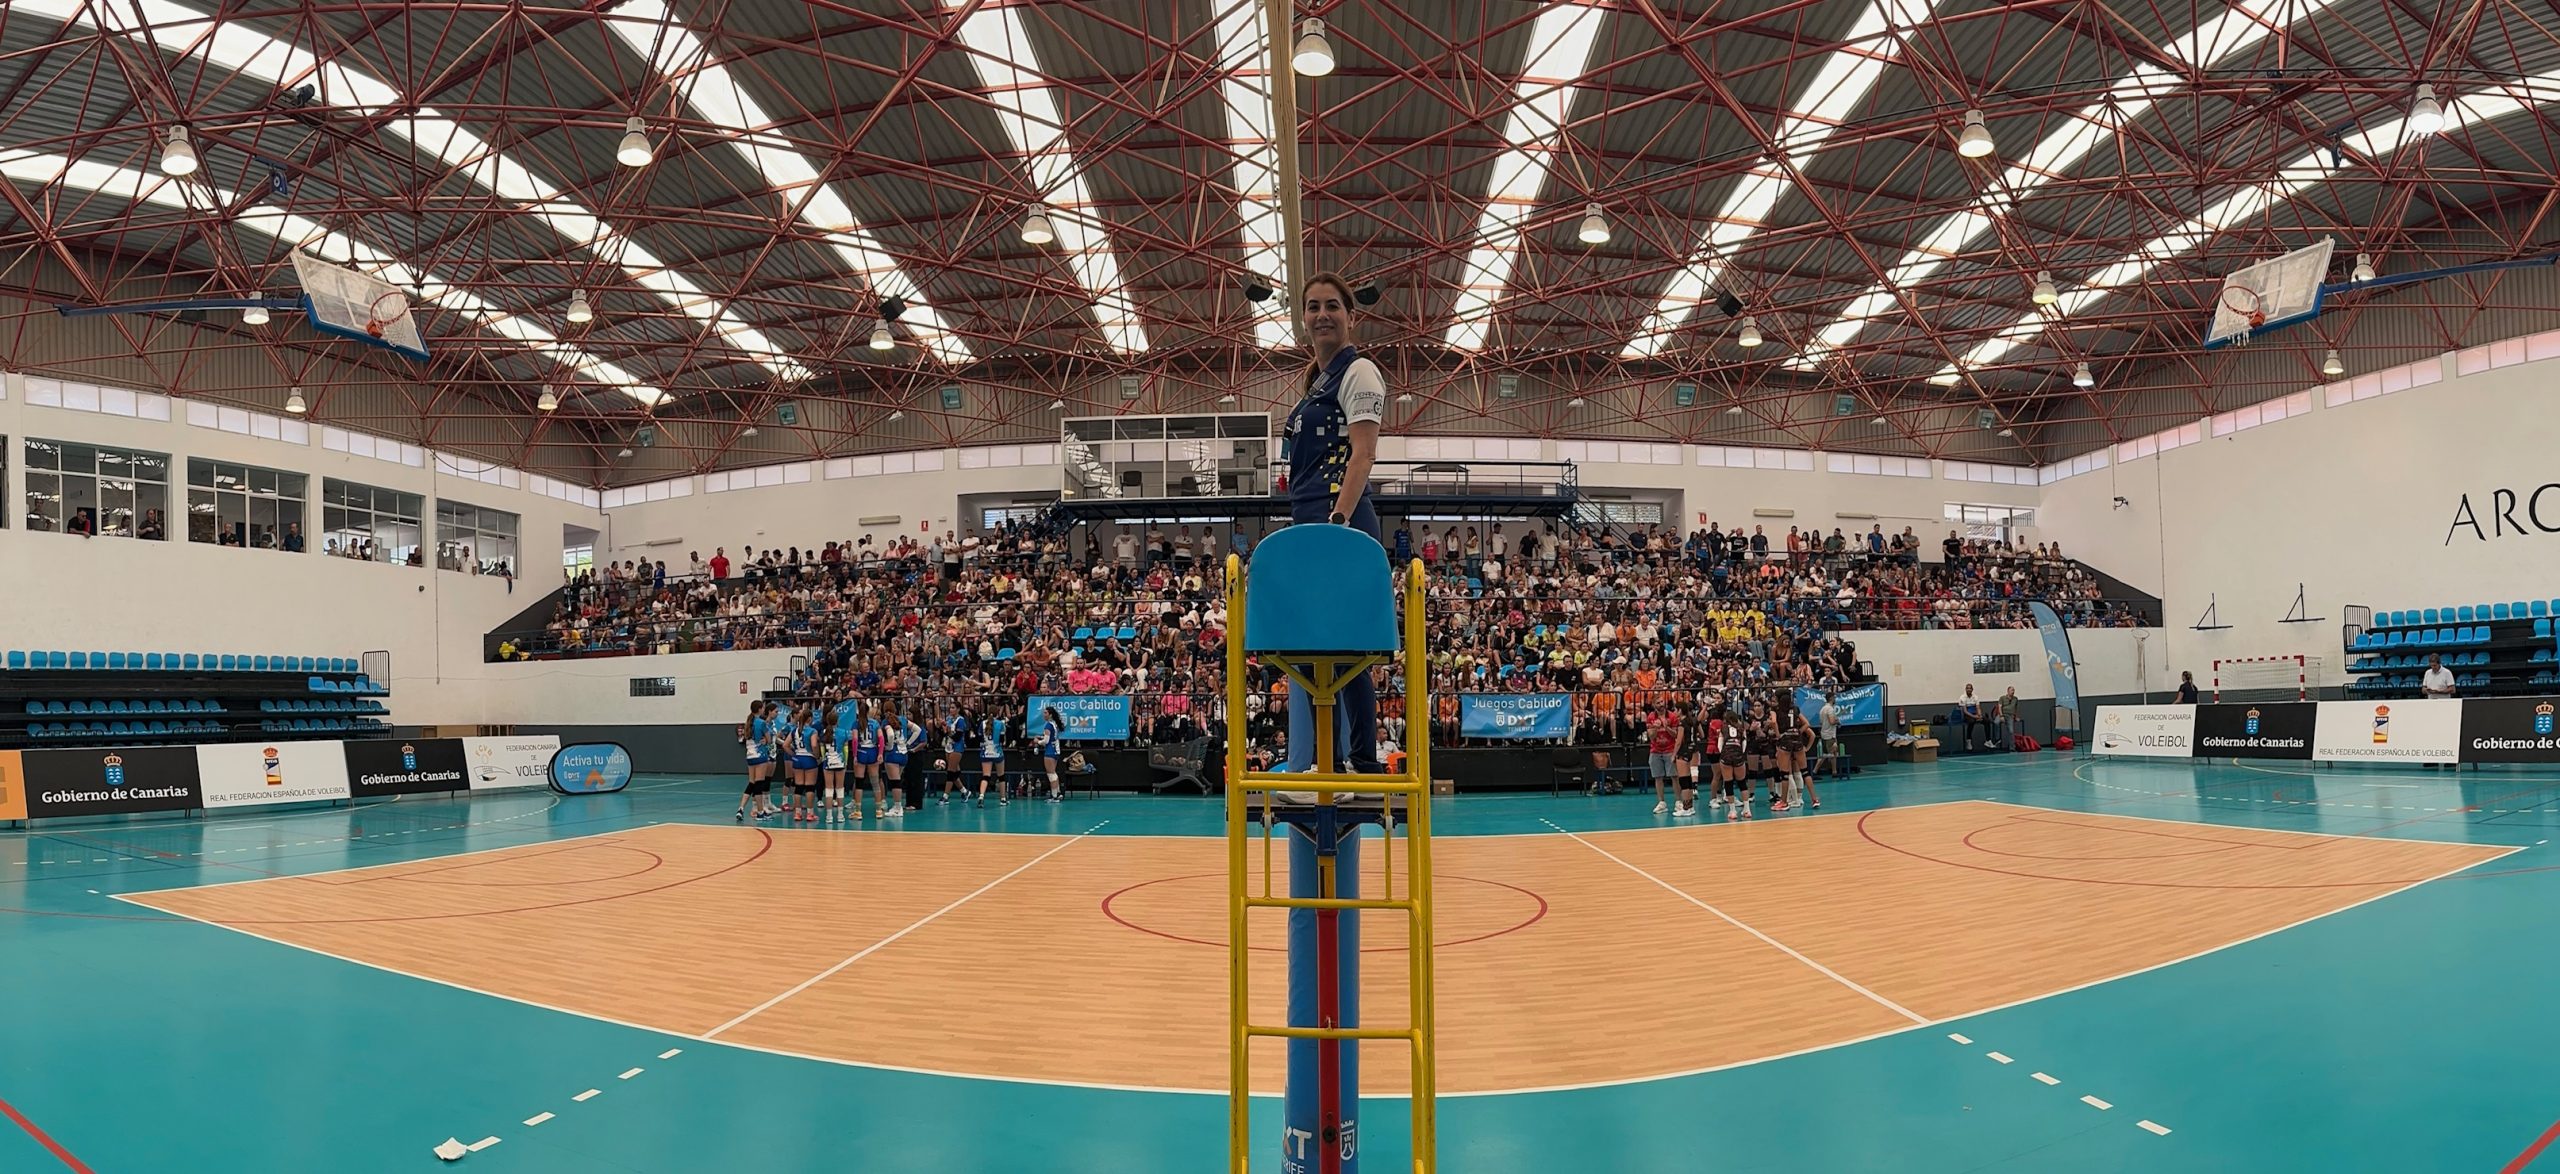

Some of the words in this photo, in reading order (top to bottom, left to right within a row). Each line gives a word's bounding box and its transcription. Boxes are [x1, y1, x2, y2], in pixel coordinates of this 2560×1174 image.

[1037, 700, 1076, 711] Juegos
[1080, 699, 1121, 710] Cabildo
[1472, 698, 1514, 711] Juegos
[1518, 698, 1562, 708] Cabildo
[1070, 716, 1098, 726] DXT
[1508, 714, 1538, 726] DXT
[2138, 736, 2187, 747] VOLEIBOL
[2203, 737, 2246, 747] Gobierno
[2247, 737, 2259, 747] de
[2260, 737, 2304, 748] Canarias
[2473, 737, 2534, 749] Gobierno
[2537, 737, 2554, 749] de
[2336, 748, 2375, 756] FEDERACION
[2377, 748, 2410, 756] ESPAÑOLA
[2422, 749, 2455, 757] VOLEIBOL
[563, 755, 592, 767] Activa
[594, 754, 604, 765] tu
[606, 752, 624, 764] vida
[515, 764, 548, 776] VOLEIB
[361, 774, 407, 785] Gobierno
[408, 772, 420, 782] de
[421, 770, 460, 781] Canarias
[42, 790, 109, 804] Gobierno
[111, 788, 128, 800] de
[130, 785, 188, 799] Canarias
[210, 794, 228, 802] REAL
[230, 791, 272, 800] FEDERACION
[273, 788, 306, 798] ESPAÑOLA
[317, 786, 346, 795] VOLEIBOL
